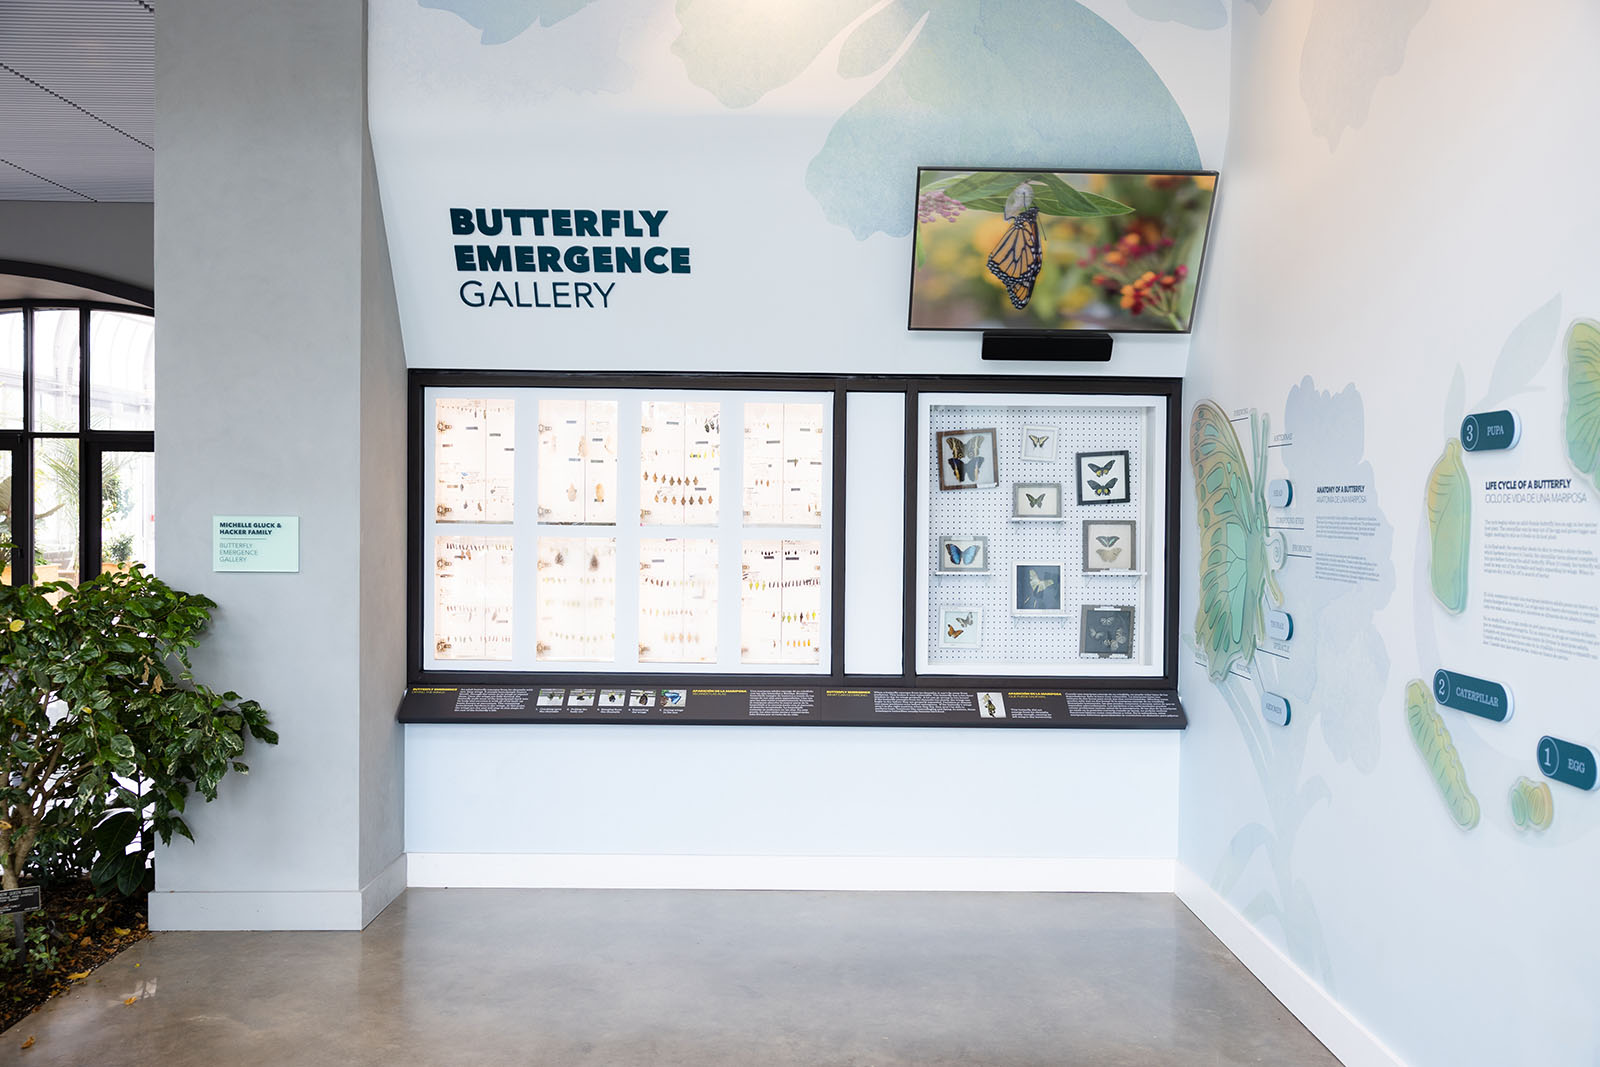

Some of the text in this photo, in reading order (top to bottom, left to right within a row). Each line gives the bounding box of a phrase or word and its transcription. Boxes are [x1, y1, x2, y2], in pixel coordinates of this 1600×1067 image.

[450, 208, 668, 238] BUTTERFLY
[454, 244, 692, 274] EMERGENCE
[458, 280, 616, 308] GALLERY
[1466, 424, 1473, 441] 3
[1487, 425, 1504, 436] PUPA
[1486, 479, 1572, 490] LIFE CYCLE OF A BUTTERFLY
[1552, 492, 1587, 503] MARIPOSA
[1438, 678, 1445, 696] 2
[1456, 686, 1499, 707] CATERPILLAR
[1544, 748, 1551, 766] 1
[1568, 758, 1585, 773] EGG
